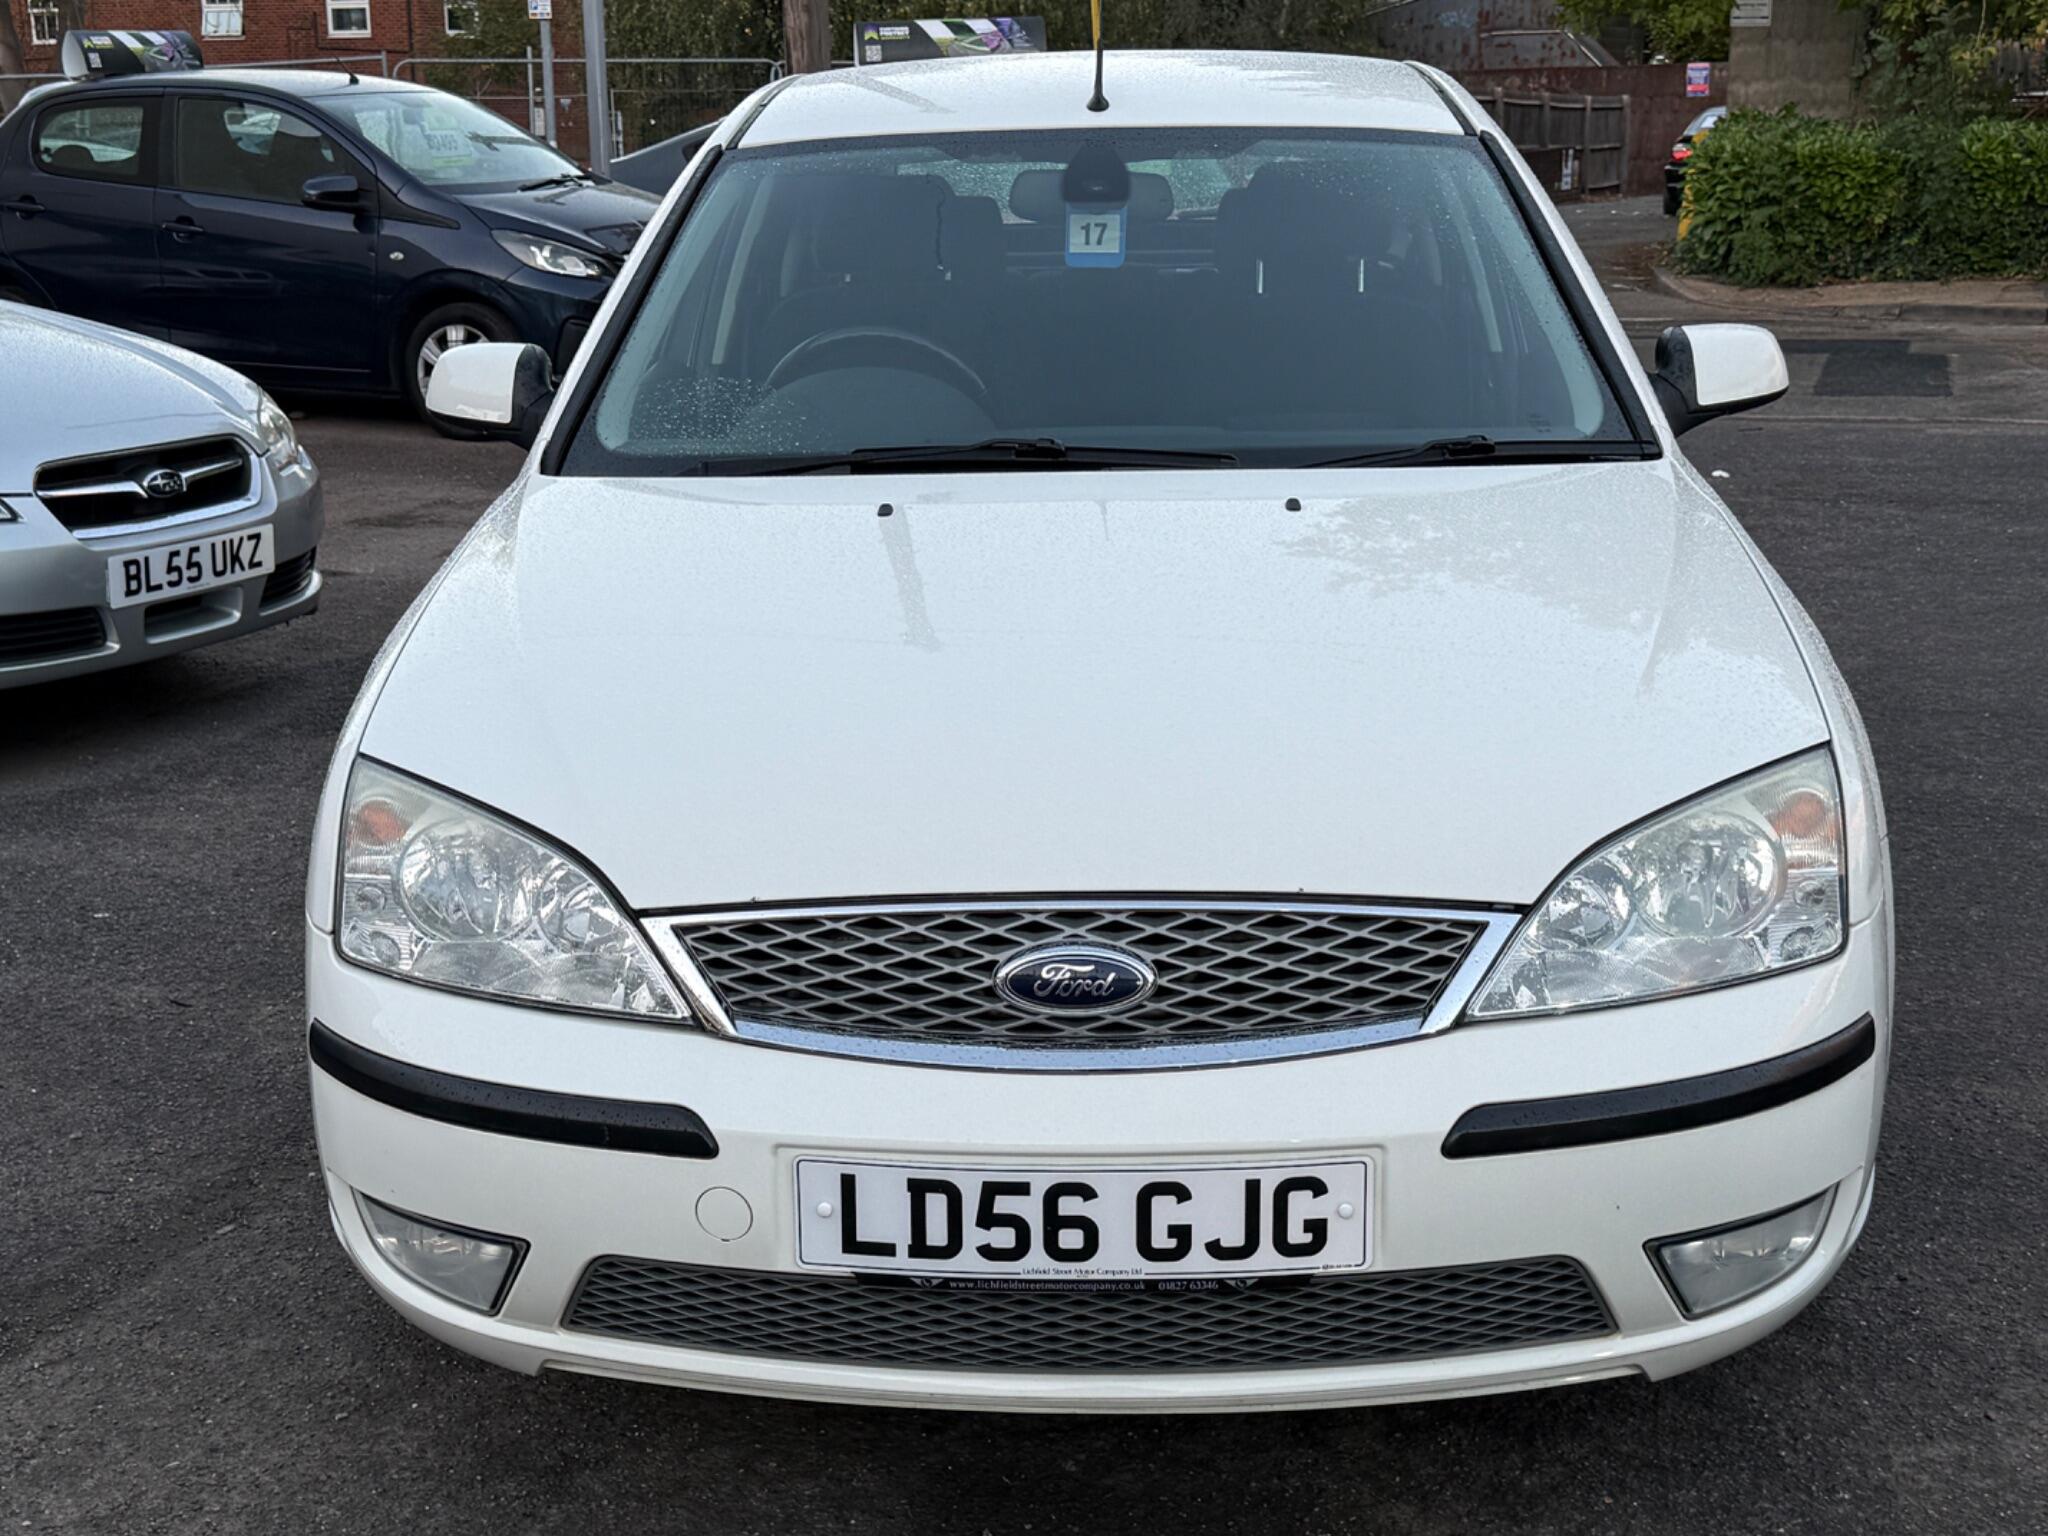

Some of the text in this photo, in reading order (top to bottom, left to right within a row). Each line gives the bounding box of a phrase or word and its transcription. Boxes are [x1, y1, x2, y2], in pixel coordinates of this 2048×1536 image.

[1081, 222, 1108, 246] 17
[123, 532, 264, 598] BL55 UKZ
[1033, 963, 1117, 997] Ford
[840, 1173, 1329, 1263] LD56 GJG
[949, 1279, 1145, 1291] www.lichfieldstreetmotorcompany.co.uk
[1158, 1280, 1187, 1290] 01827
[1052, 1267, 1072, 1276] Street
[1096, 1267, 1130, 1277] Company
